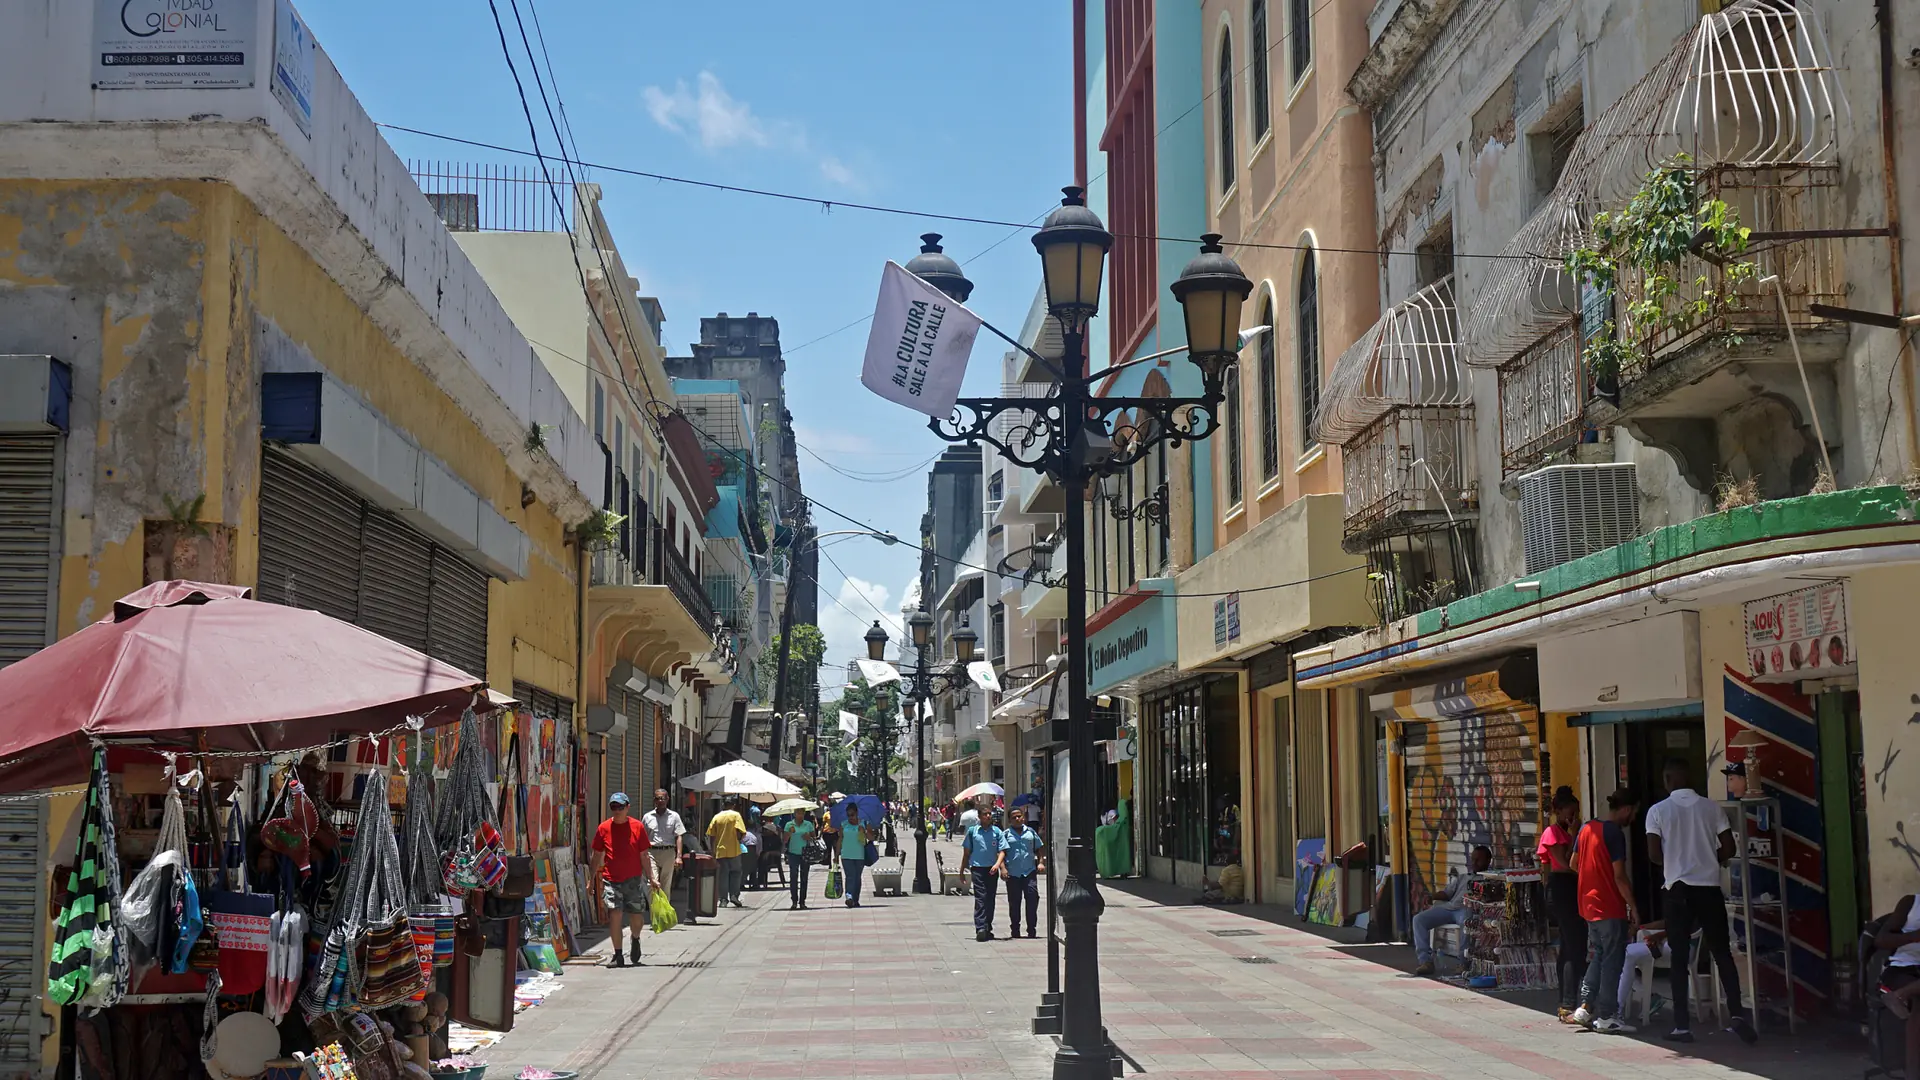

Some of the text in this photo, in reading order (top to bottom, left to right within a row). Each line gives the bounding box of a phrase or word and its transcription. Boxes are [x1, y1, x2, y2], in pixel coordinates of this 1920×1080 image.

[891, 299, 929, 388] #LA CULTURA
[908, 303, 946, 397] SALE A LA CALLE
[1094, 649, 1100, 672] El
[1117, 626, 1148, 661] Deportivo
